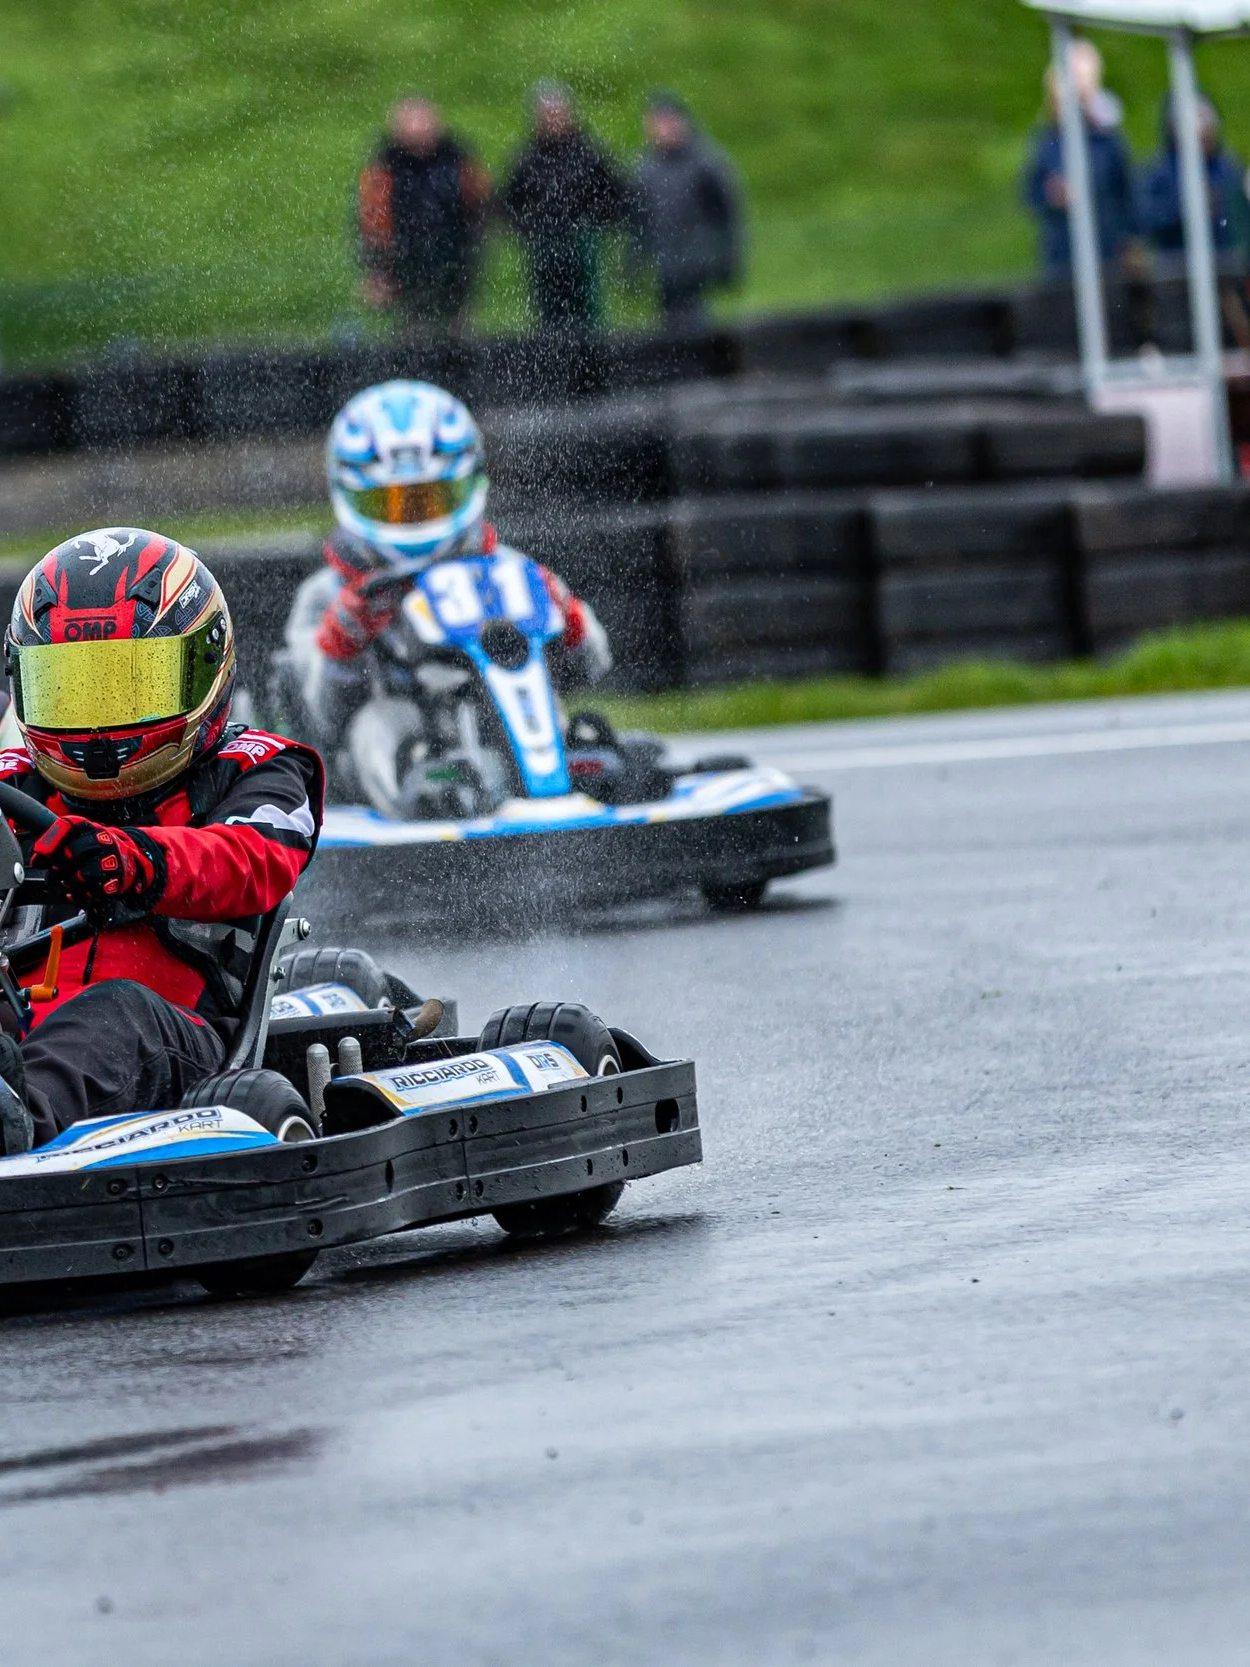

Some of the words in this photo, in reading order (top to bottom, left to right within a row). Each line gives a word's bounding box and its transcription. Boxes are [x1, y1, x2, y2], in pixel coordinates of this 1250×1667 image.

[426, 561, 534, 627] 31
[63, 620, 118, 641] OMP
[222, 742, 267, 758] OMP
[391, 1058, 491, 1091] RICCIARDO
[476, 1070, 500, 1085] KART
[178, 1119, 224, 1132] KART
